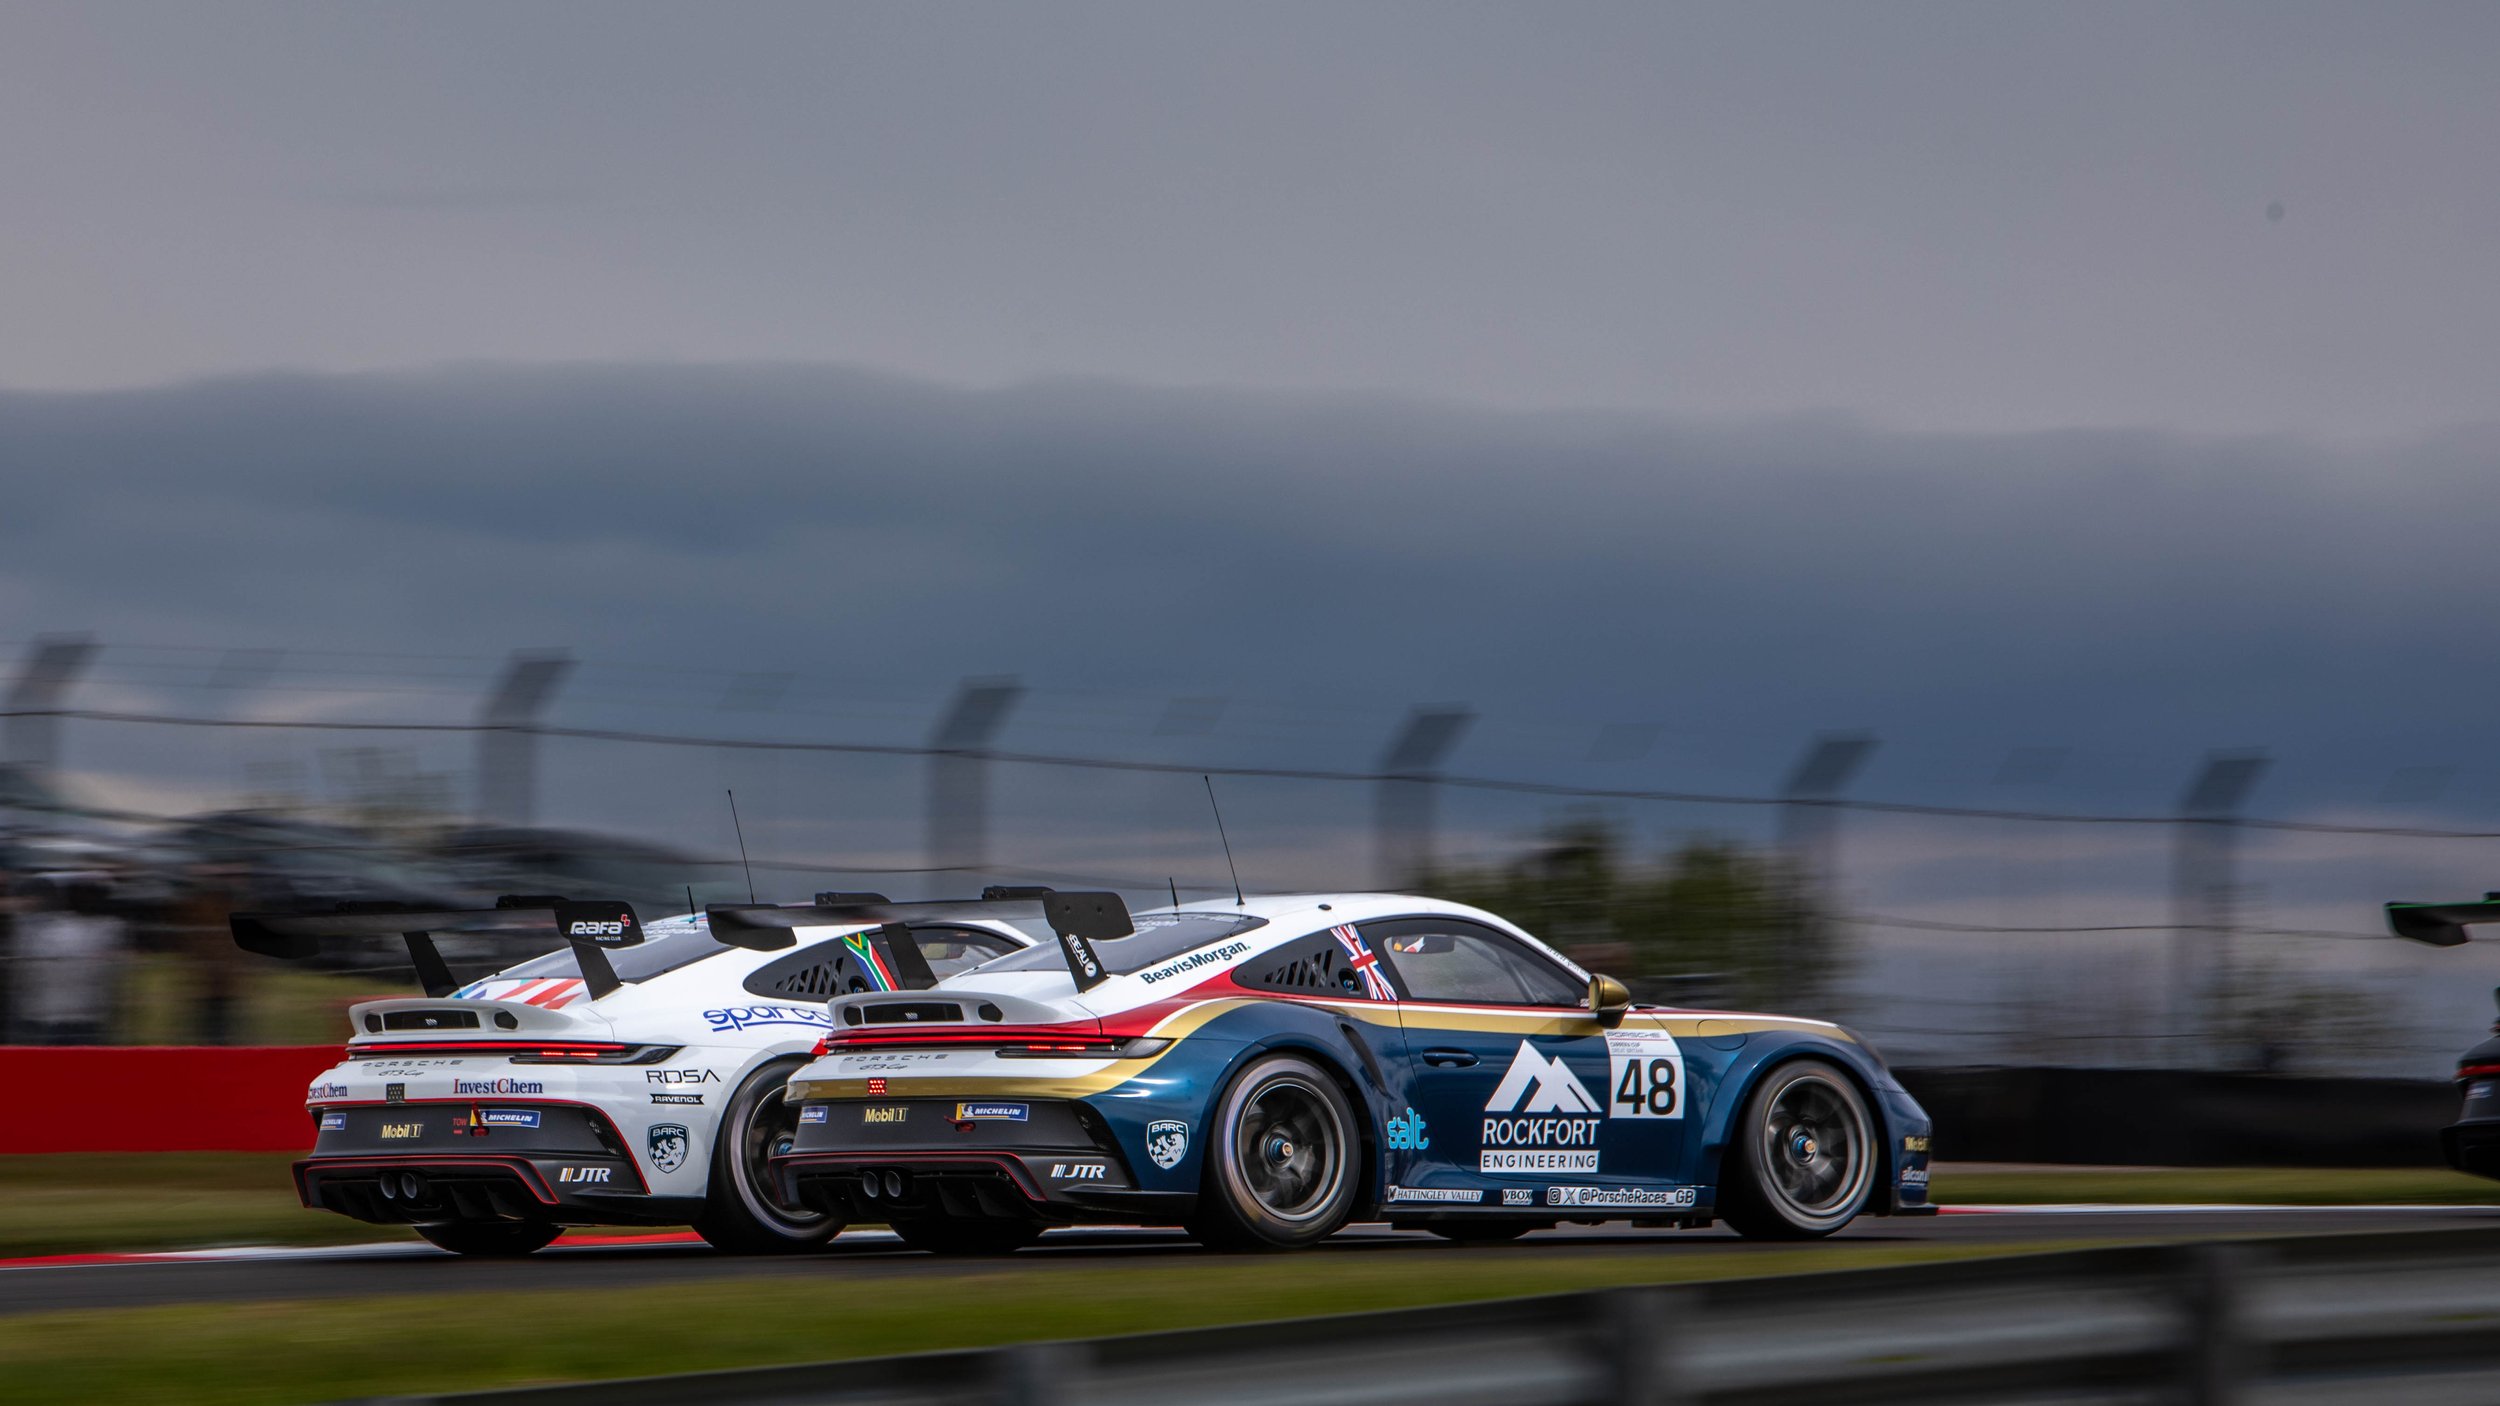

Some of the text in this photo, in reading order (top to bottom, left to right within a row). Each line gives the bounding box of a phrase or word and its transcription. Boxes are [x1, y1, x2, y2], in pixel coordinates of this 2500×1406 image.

[703, 1006, 832, 1031] sparco
[842, 1054, 948, 1062] PORSCHE
[378, 1069, 403, 1077] GT3
[453, 1078, 543, 1094] InvestChem
[1616, 1058, 1676, 1115] 48
[864, 1108, 894, 1122] Mobil
[382, 1125, 409, 1138] Mobil
[653, 1128, 684, 1137] BARC
[1152, 1124, 1184, 1133] BARC
[1387, 1107, 1429, 1149] salt
[1482, 1119, 1601, 1145] ROCKFORT
[1483, 1155, 1596, 1168] ENGINEERING
[573, 1168, 610, 1182] JTR
[1065, 1165, 1106, 1178] JTR
[1398, 1191, 1481, 1200] HATTINGLEY VALLEY
[1504, 1191, 1532, 1199] VBOX
[1579, 1189, 1694, 1205] @PorscheRaces_GB
